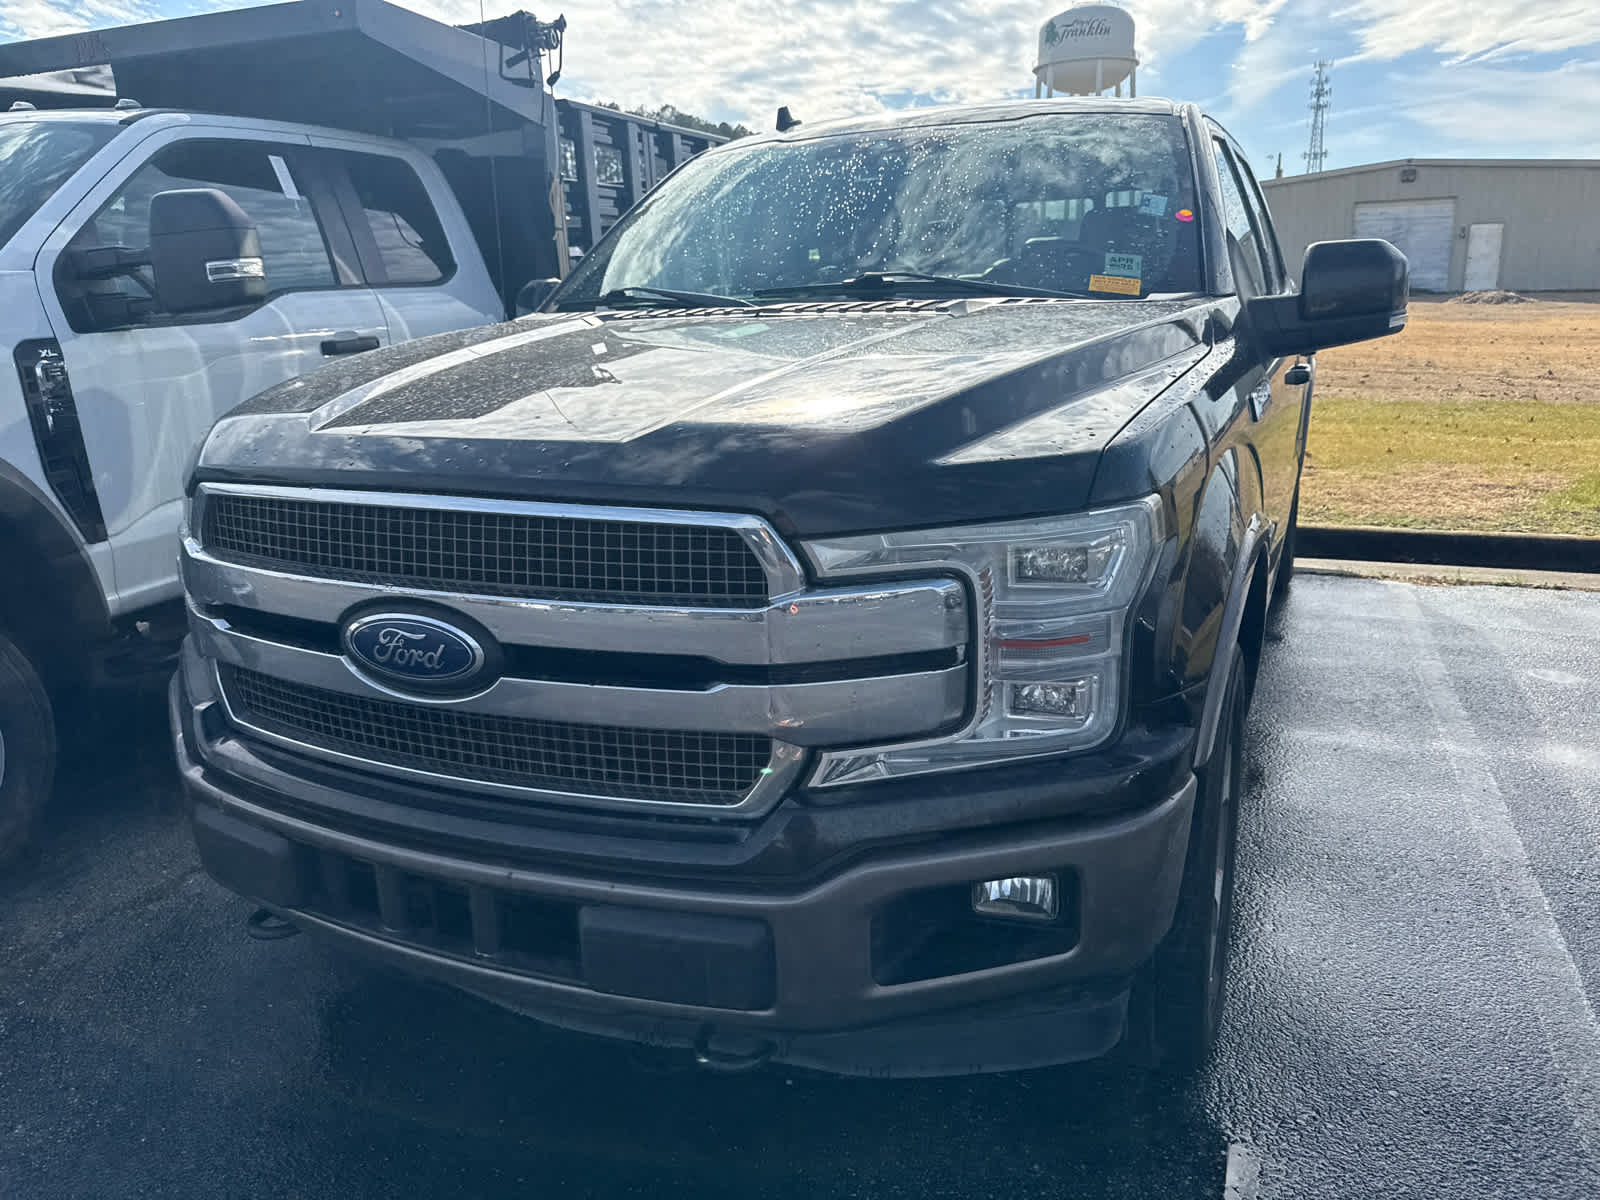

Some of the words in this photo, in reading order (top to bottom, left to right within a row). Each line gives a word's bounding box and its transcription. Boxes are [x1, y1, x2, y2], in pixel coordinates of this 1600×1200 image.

[1056, 17, 1112, 43] Franklin
[38, 349, 59, 358] XL
[374, 627, 445, 669] Ford
